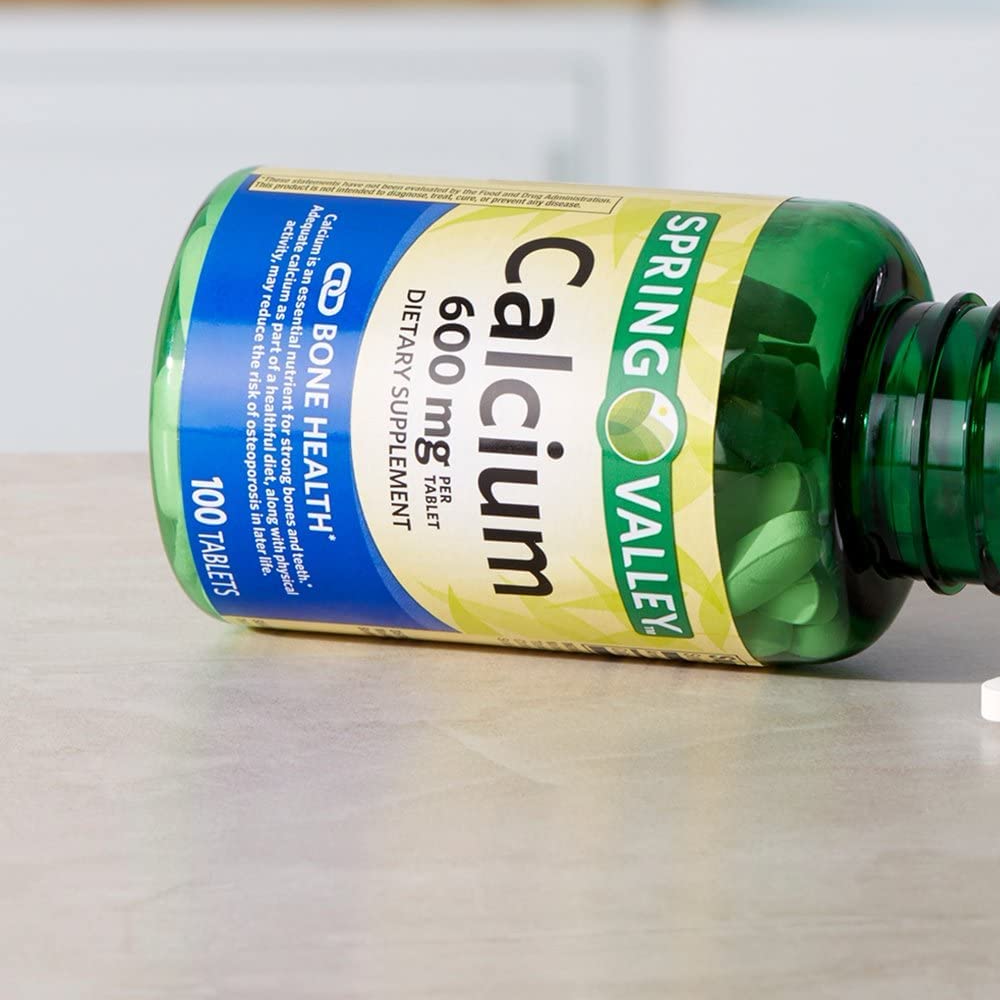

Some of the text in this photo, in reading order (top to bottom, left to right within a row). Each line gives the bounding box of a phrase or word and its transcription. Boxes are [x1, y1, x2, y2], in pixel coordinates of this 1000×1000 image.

[274, 182, 310, 191] product
[336, 186, 376, 195] intended
[376, 188, 386, 196] to
[387, 189, 428, 199] diagnose,
[490, 197, 526, 206] prevent
[526, 199, 544, 207] any
[544, 200, 581, 209] disease.
[291, 179, 340, 187] statements
[381, 183, 403, 191] been
[405, 185, 449, 194] evaluated
[450, 188, 462, 196] by
[521, 192, 544, 201] Drug
[544, 194, 611, 204] Administration.
[310, 213, 338, 255] Calcium
[301, 269, 314, 284] an
[306, 257, 321, 267] is
[288, 286, 309, 348] essential
[622, 214, 708, 376] SPRING
[282, 351, 297, 411] nutrient
[304, 323, 338, 409] BONE
[414, 296, 475, 467] 600 mg
[244, 220, 296, 576] activity, may reduce the risk of osteoporosis in later life.
[263, 204, 324, 595] Adequate calcium as part of a healthful diet, along with physical
[281, 414, 294, 436] for
[388, 289, 426, 531] DIETARY SUPPLEMENT
[478, 237, 595, 596] Calcium
[279, 438, 293, 485] strong
[282, 486, 296, 526] bones
[424, 475, 440, 529] TABLET
[438, 475, 452, 503] PER
[190, 477, 240, 597] 100 TABLETS
[287, 529, 304, 551] and
